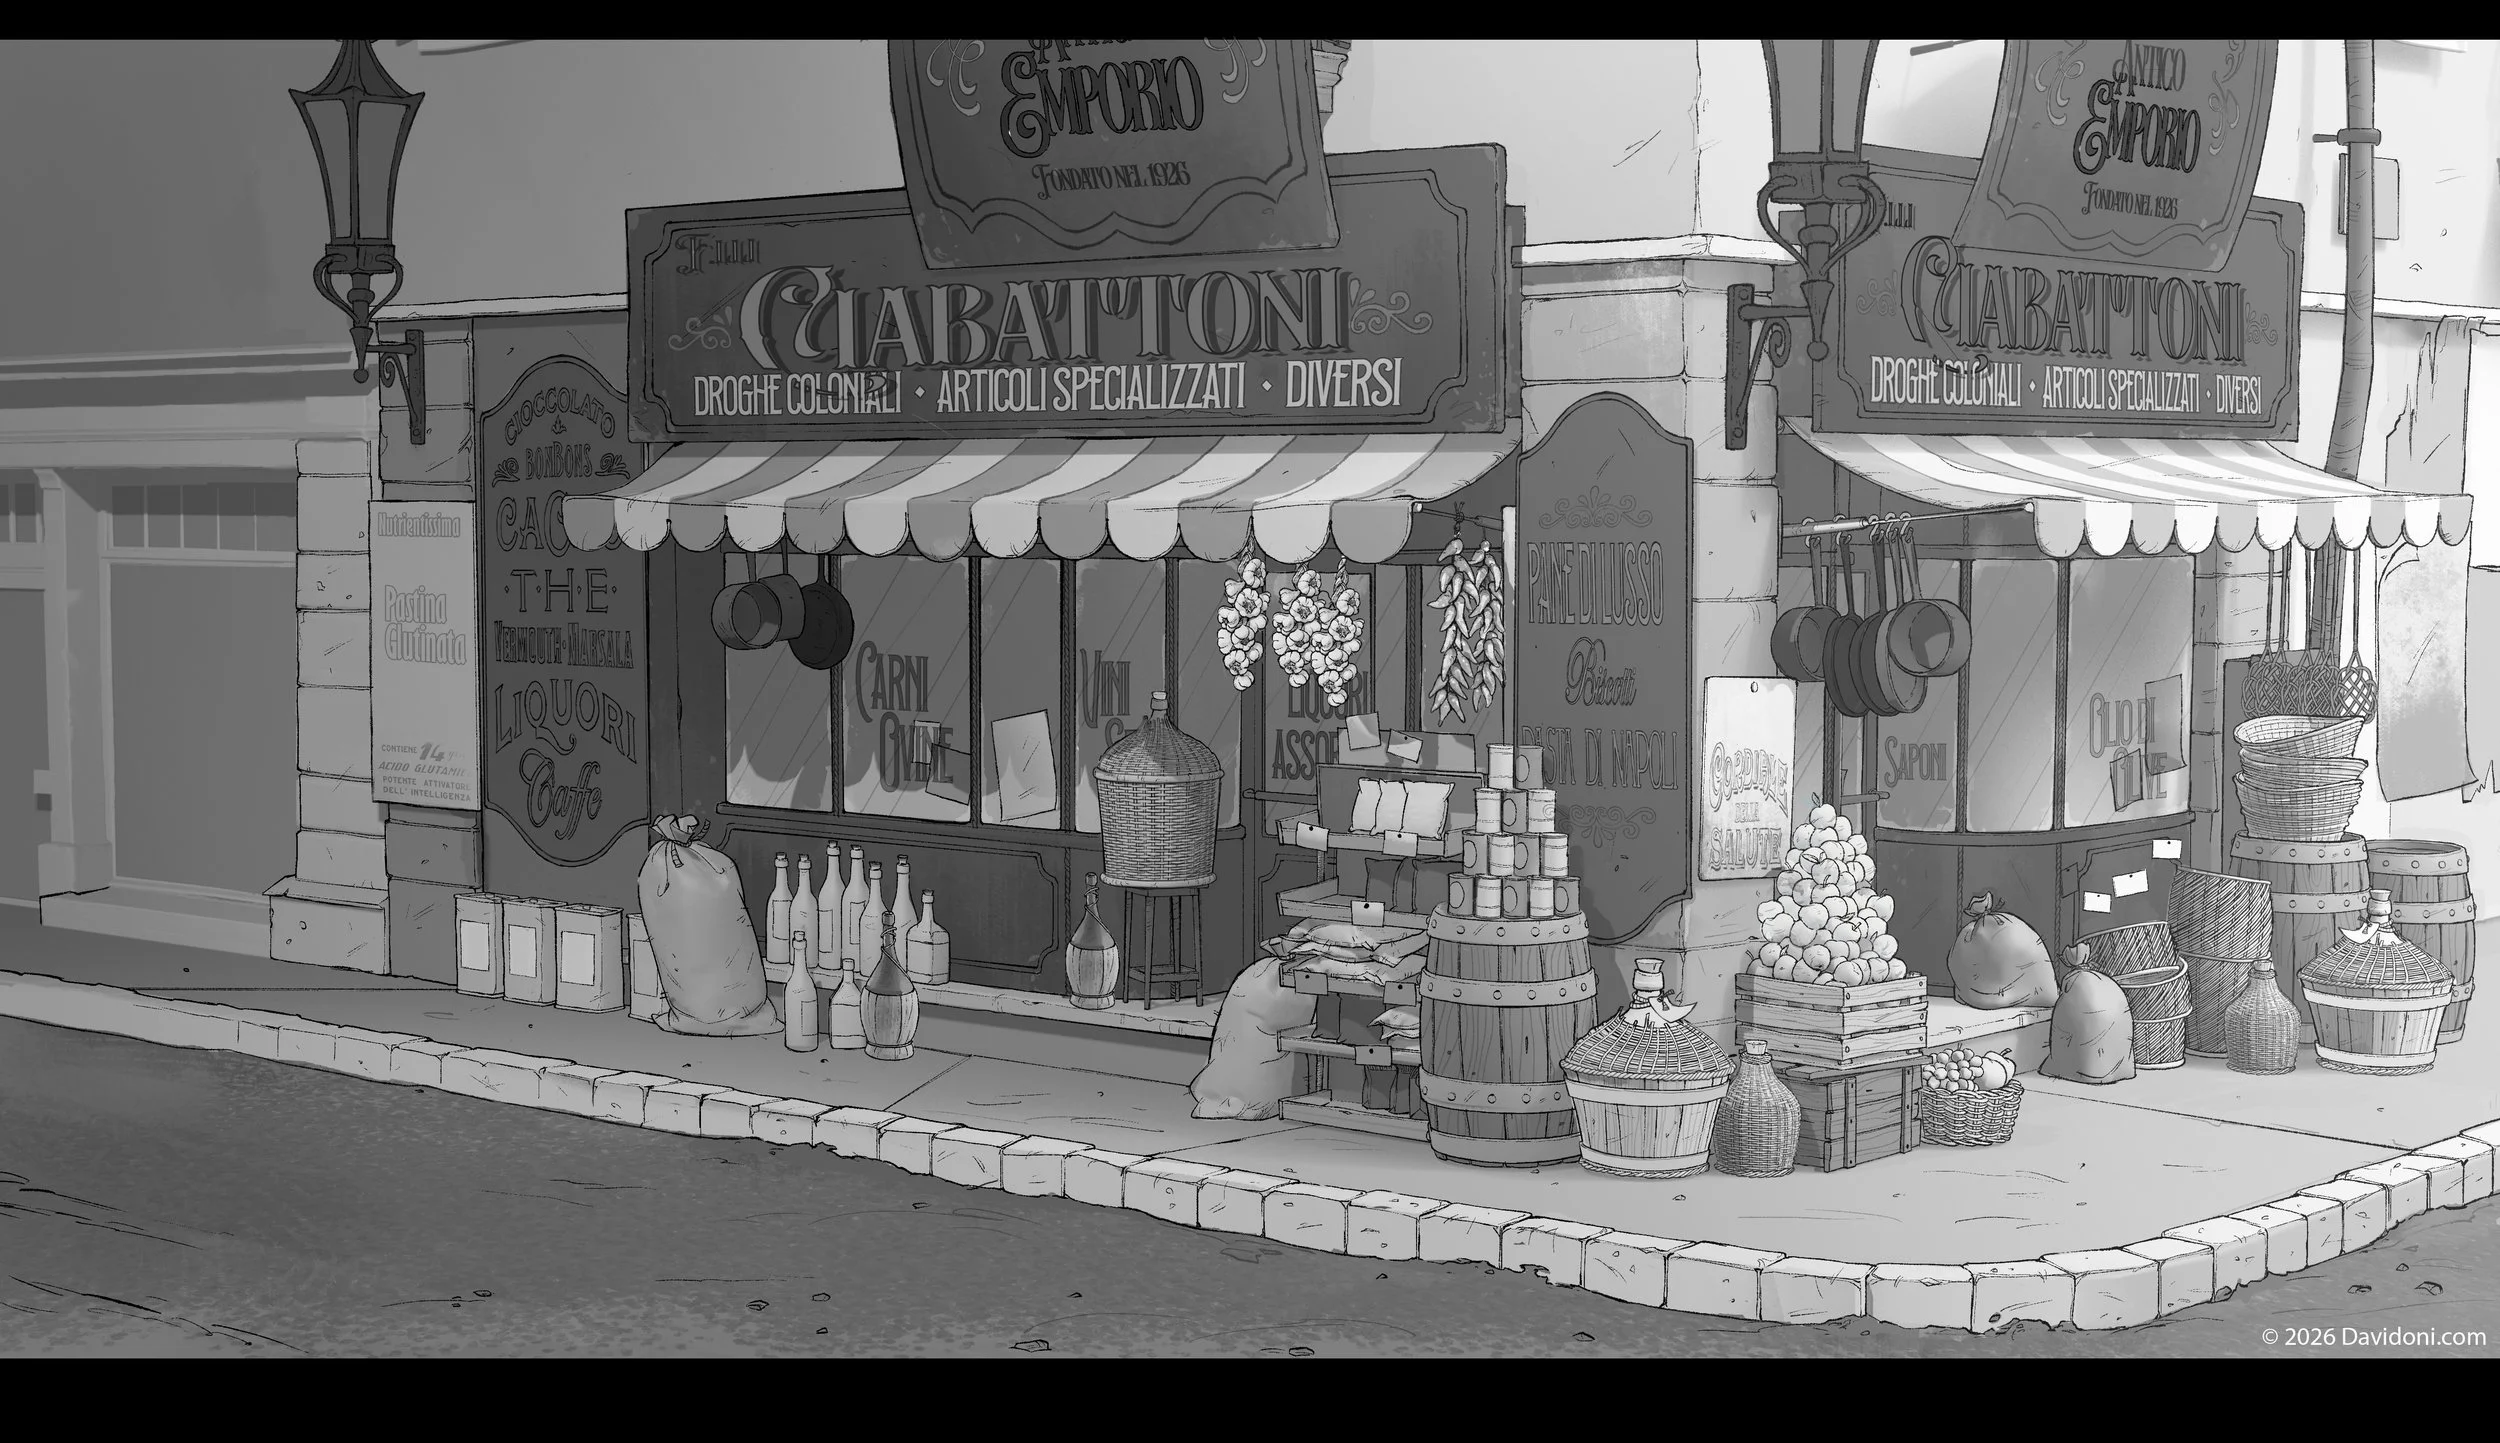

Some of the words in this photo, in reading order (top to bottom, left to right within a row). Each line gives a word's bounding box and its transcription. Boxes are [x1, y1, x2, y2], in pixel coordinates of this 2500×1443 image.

[1000, 51, 1204, 158] EMPORIO
[2073, 79, 2201, 175] EMPORIO
[1032, 164, 1113, 200] FONDATO
[1112, 164, 1146, 188] NEL
[1147, 161, 1191, 187] 1926
[2081, 181, 2134, 215] FONDATO
[2134, 194, 2153, 217] NEL
[2154, 196, 2178, 220] 1926
[740, 263, 1353, 372] CIABATTONI
[1901, 235, 2244, 362] CIABATTONI
[693, 374, 783, 417] DROGHE
[785, 370, 903, 416] COLONIALI
[936, 367, 1047, 413] ARTICOLI
[1052, 362, 1247, 412] SPECIALIZZATI
[1285, 358, 1403, 408] DIVERSI
[1870, 356, 1940, 404] DROGHE
[1942, 358, 2022, 407] COLONIALI
[2042, 365, 2105, 410] ARTICOLI
[2108, 369, 2200, 413] SPECIALIZZATI
[2216, 374, 2262, 415] DIVERSI
[505, 386, 616, 446] CIOCCOLATO
[526, 441, 593, 478] BONBONS
[377, 511, 461, 538] Nutrientissima
[496, 489, 622, 558] CAC
[384, 584, 448, 624] Pastina
[1527, 541, 1575, 625] PANE
[1578, 541, 1598, 625] DI
[1600, 541, 1664, 627] LUSSO
[384, 621, 468, 666] Glutinata
[493, 620, 563, 664] VERMOUTH
[567, 622, 635, 669] MARSALA
[1565, 636, 1638, 707] Biscotti
[855, 640, 929, 723] CARNI
[1080, 648, 1130, 729] VINI
[381, 744, 418, 754] CONTIENE
[419, 742, 446, 761] 14
[495, 679, 637, 765] LIQUORI
[880, 711, 954, 793] OVINE
[2089, 692, 2133, 758] OLIO
[2137, 697, 2156, 744] DI
[378, 761, 411, 772] ACIDO
[383, 776, 417, 786] POTENTE
[1585, 728, 1603, 786] DI
[1612, 729, 1679, 790] NAPOLI
[1709, 741, 1789, 818] CORDIALE
[1884, 735, 1947, 788] SAPONI
[2113, 746, 2168, 813] OLIVE
[383, 786, 408, 795] DELL'
[411, 789, 472, 802] INTELLIGENZA
[1709, 827, 1784, 870] SALUTE
